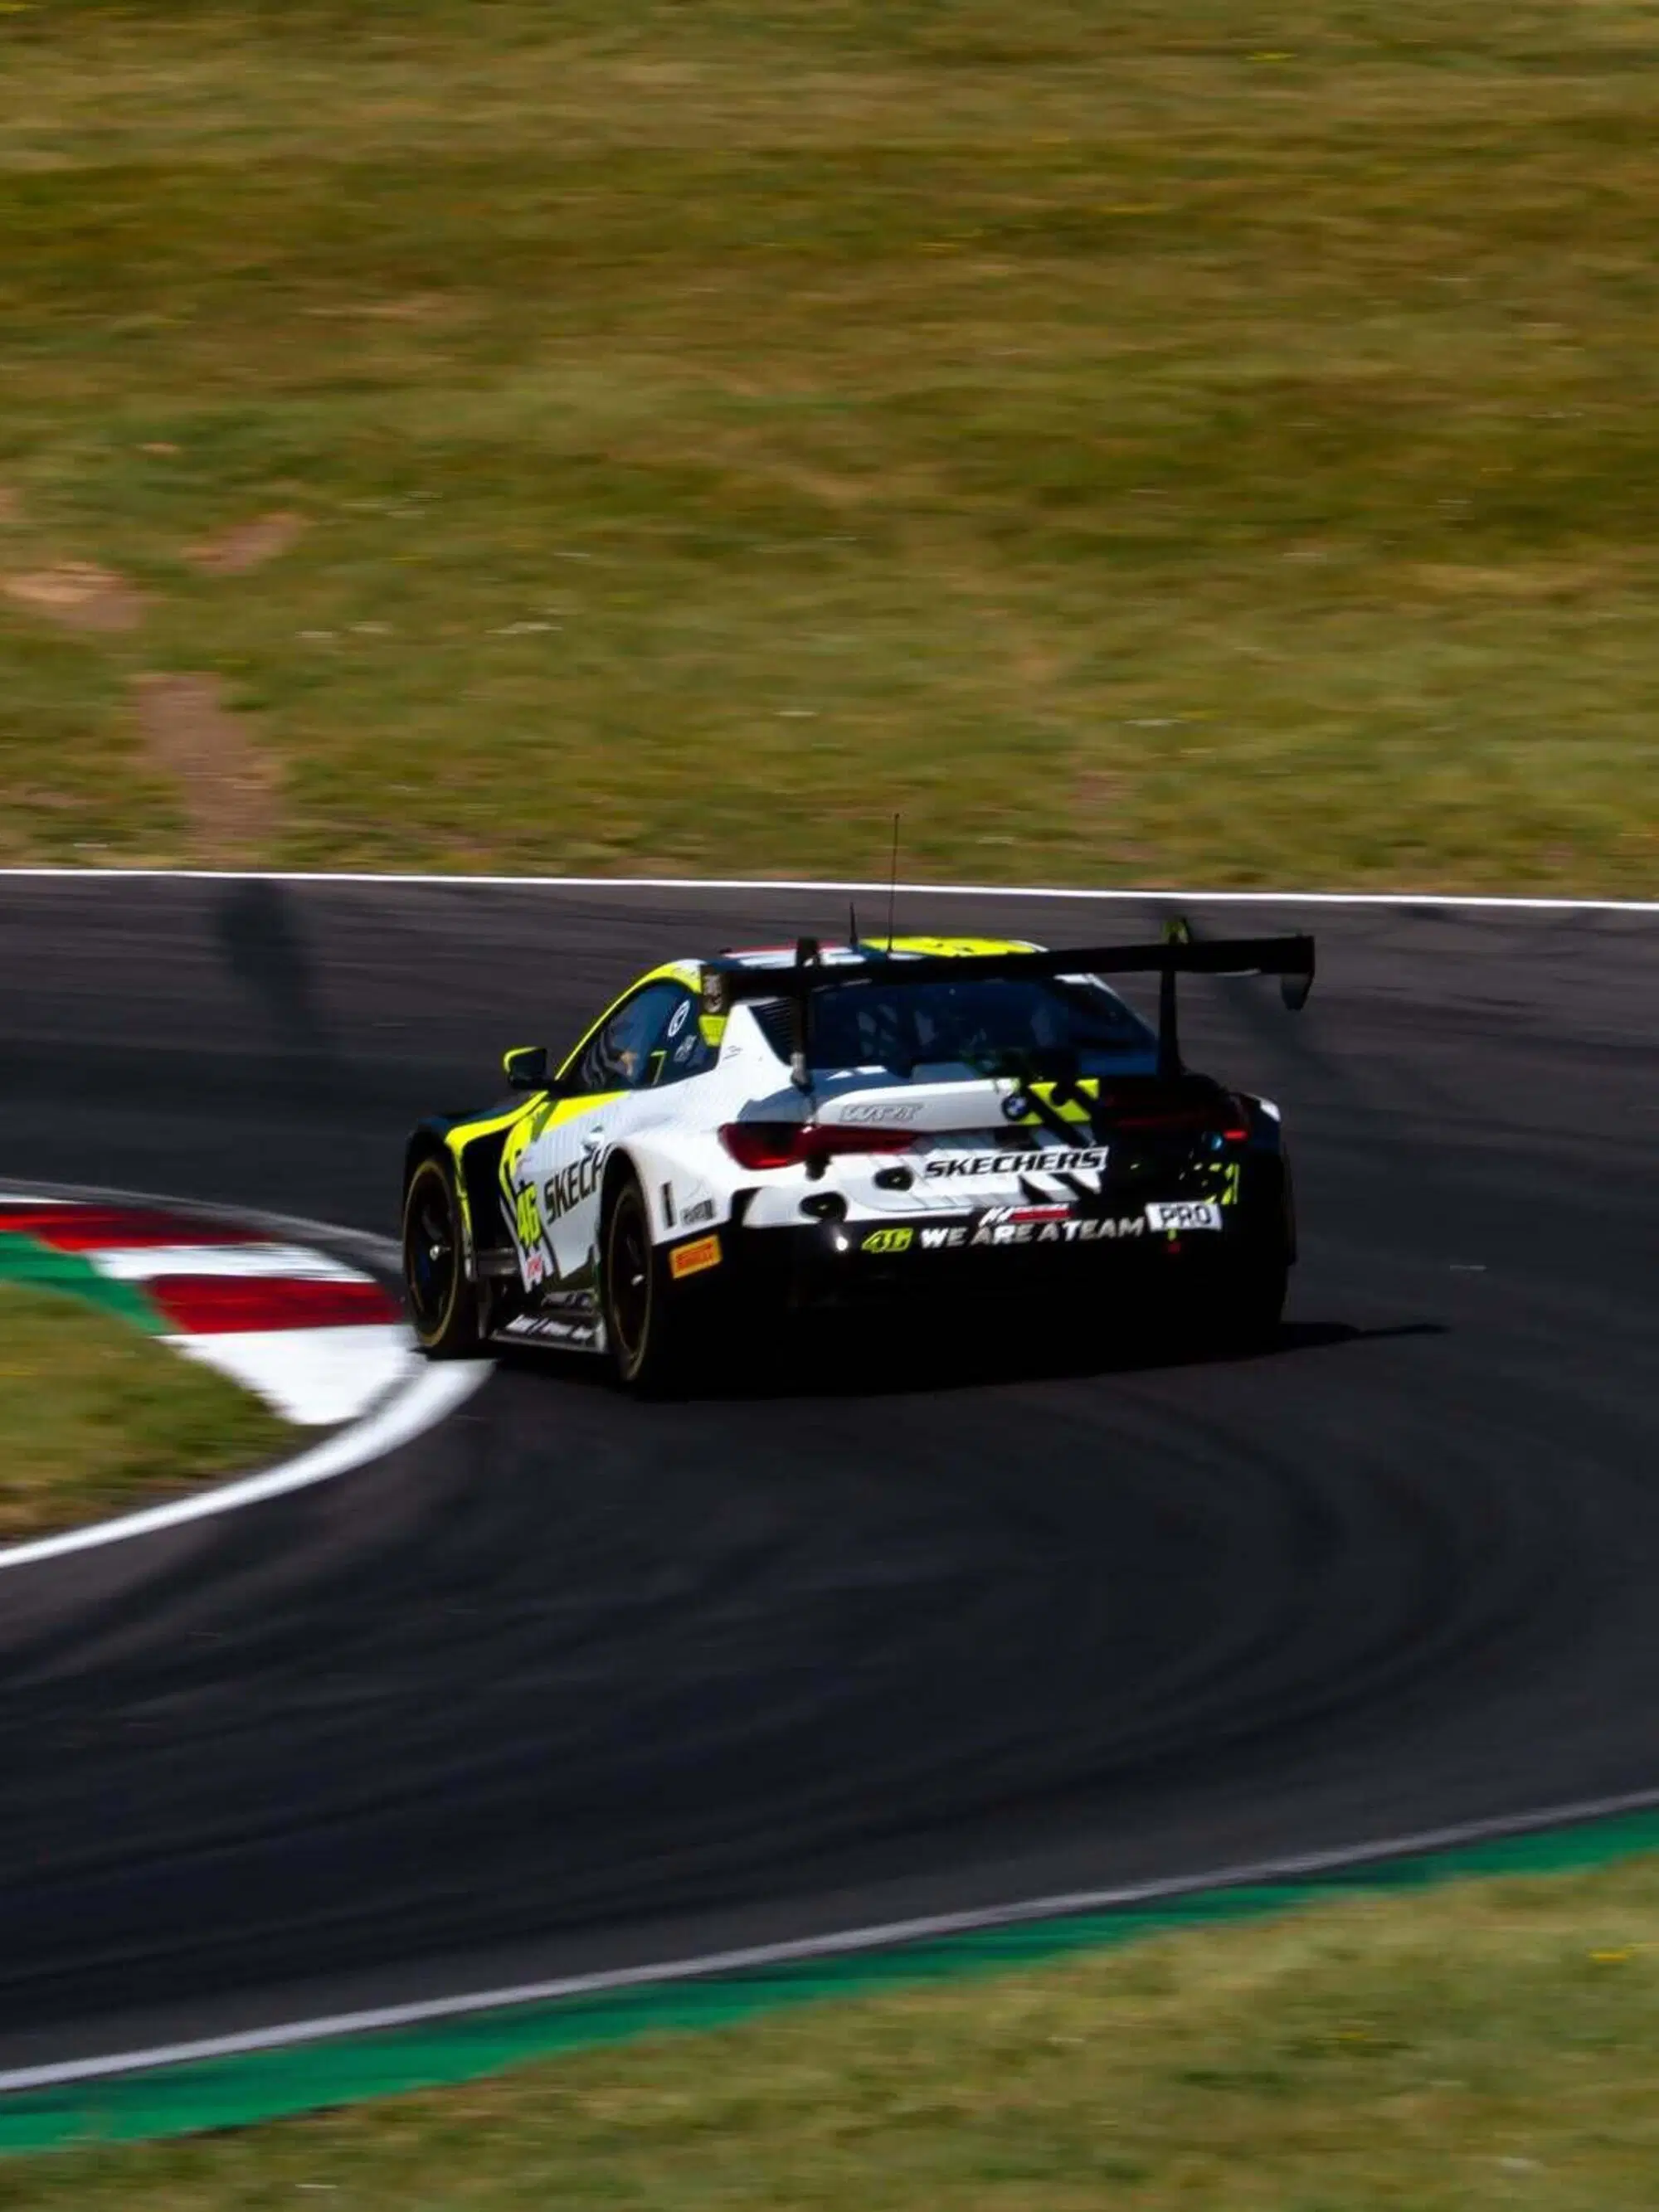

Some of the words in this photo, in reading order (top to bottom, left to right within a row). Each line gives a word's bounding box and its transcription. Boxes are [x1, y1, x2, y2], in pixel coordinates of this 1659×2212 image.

[924, 1149, 1102, 1178] SKECHERS
[1159, 1203, 1214, 1227] PRO
[920, 1226, 968, 1249] WE
[970, 1223, 1034, 1246] ARE
[1036, 1220, 1059, 1242] A
[1061, 1216, 1146, 1242] TEAM
